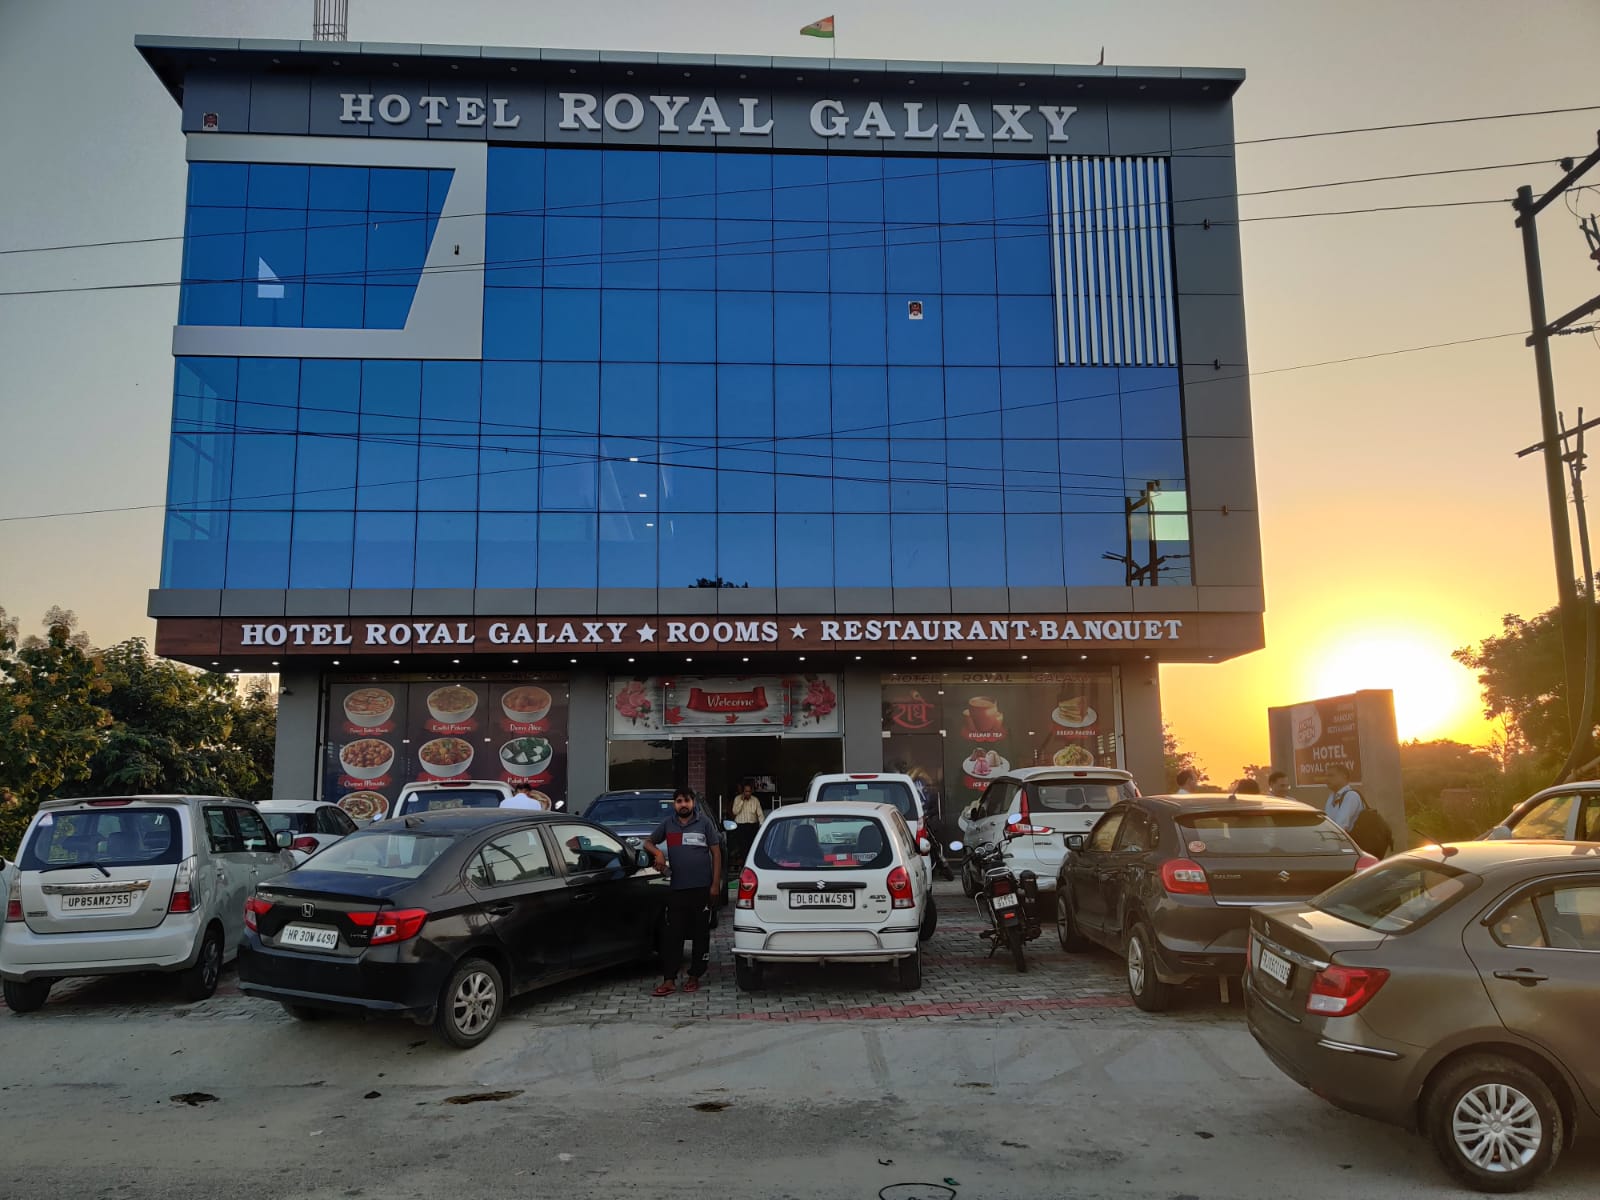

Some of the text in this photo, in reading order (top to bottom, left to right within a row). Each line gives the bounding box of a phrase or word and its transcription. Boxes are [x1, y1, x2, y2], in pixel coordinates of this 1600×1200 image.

[338, 92, 1078, 143] HOTEL ROYAL GALAXY
[241, 619, 1183, 647] HOTEL ROYAL GALAXY ROOMS RESTAURANT BANQUET
[961, 674, 1014, 683] ROYAL
[707, 695, 755, 707] Welcome
[1313, 743, 1347, 760] HOTEL
[1300, 763, 1324, 774] ROYAL
[68, 893, 129, 909] UP85AM2755
[796, 893, 854, 904] DL8CAW4581
[287, 929, 299, 941] HR
